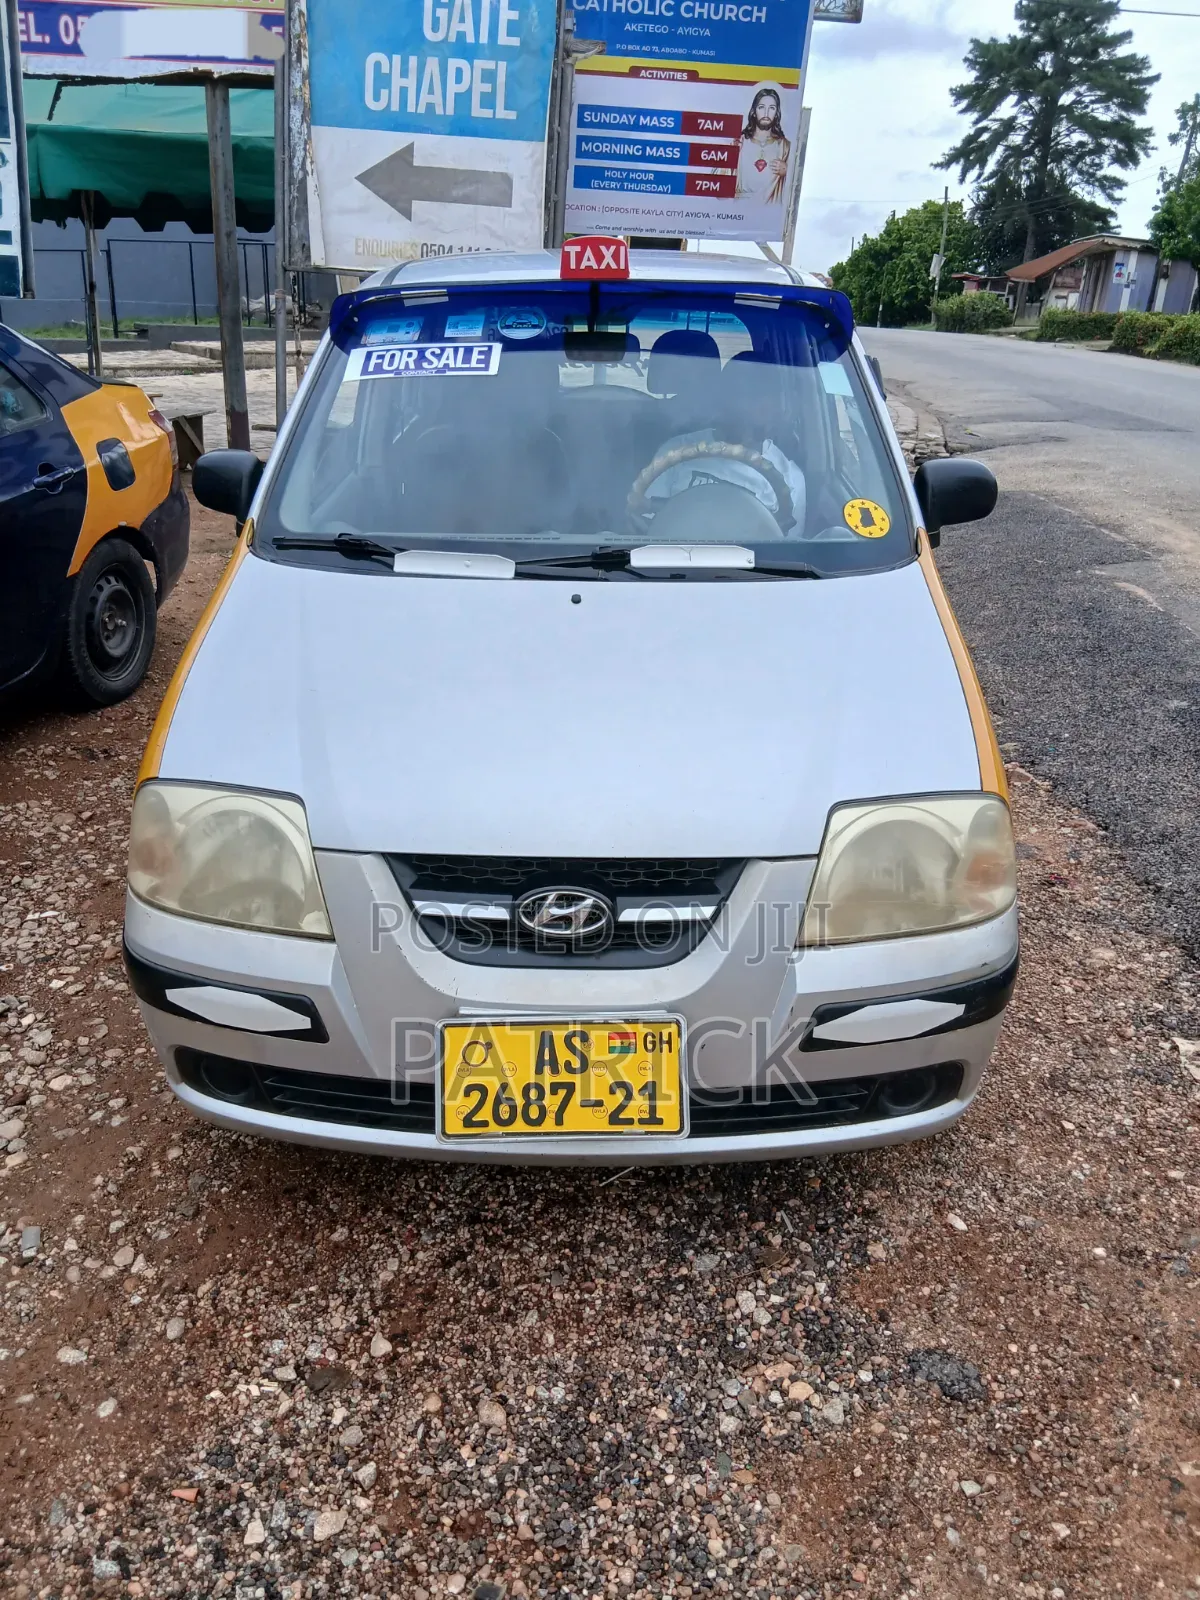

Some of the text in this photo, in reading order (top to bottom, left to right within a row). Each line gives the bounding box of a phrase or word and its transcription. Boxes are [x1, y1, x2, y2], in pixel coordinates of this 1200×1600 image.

[423, 0, 521, 46] GATE
[571, 0, 767, 24] CATHOLIC CHURCH
[624, 22, 669, 34] AKETEGO
[677, 26, 711, 37] AYIGYA
[639, 69, 688, 80] ACTIVITIES
[364, 52, 517, 120] CHAPEL
[583, 111, 724, 131] SUNDAY MASS 7AM
[581, 142, 728, 162] MORNING MASS 6AM
[604, 169, 654, 181] HOLY HOUR
[591, 180, 720, 194] (EVERY THURSDAY) 7PM
[641, 208, 664, 216] KAYLA
[685, 211, 710, 219] AYIGYA
[354, 237, 418, 259] ENQUIRIES
[564, 245, 626, 270] TAXI
[367, 346, 489, 372] FOR SALE
[534, 1030, 673, 1075] AS GH
[462, 1081, 665, 1128] 2687-21
